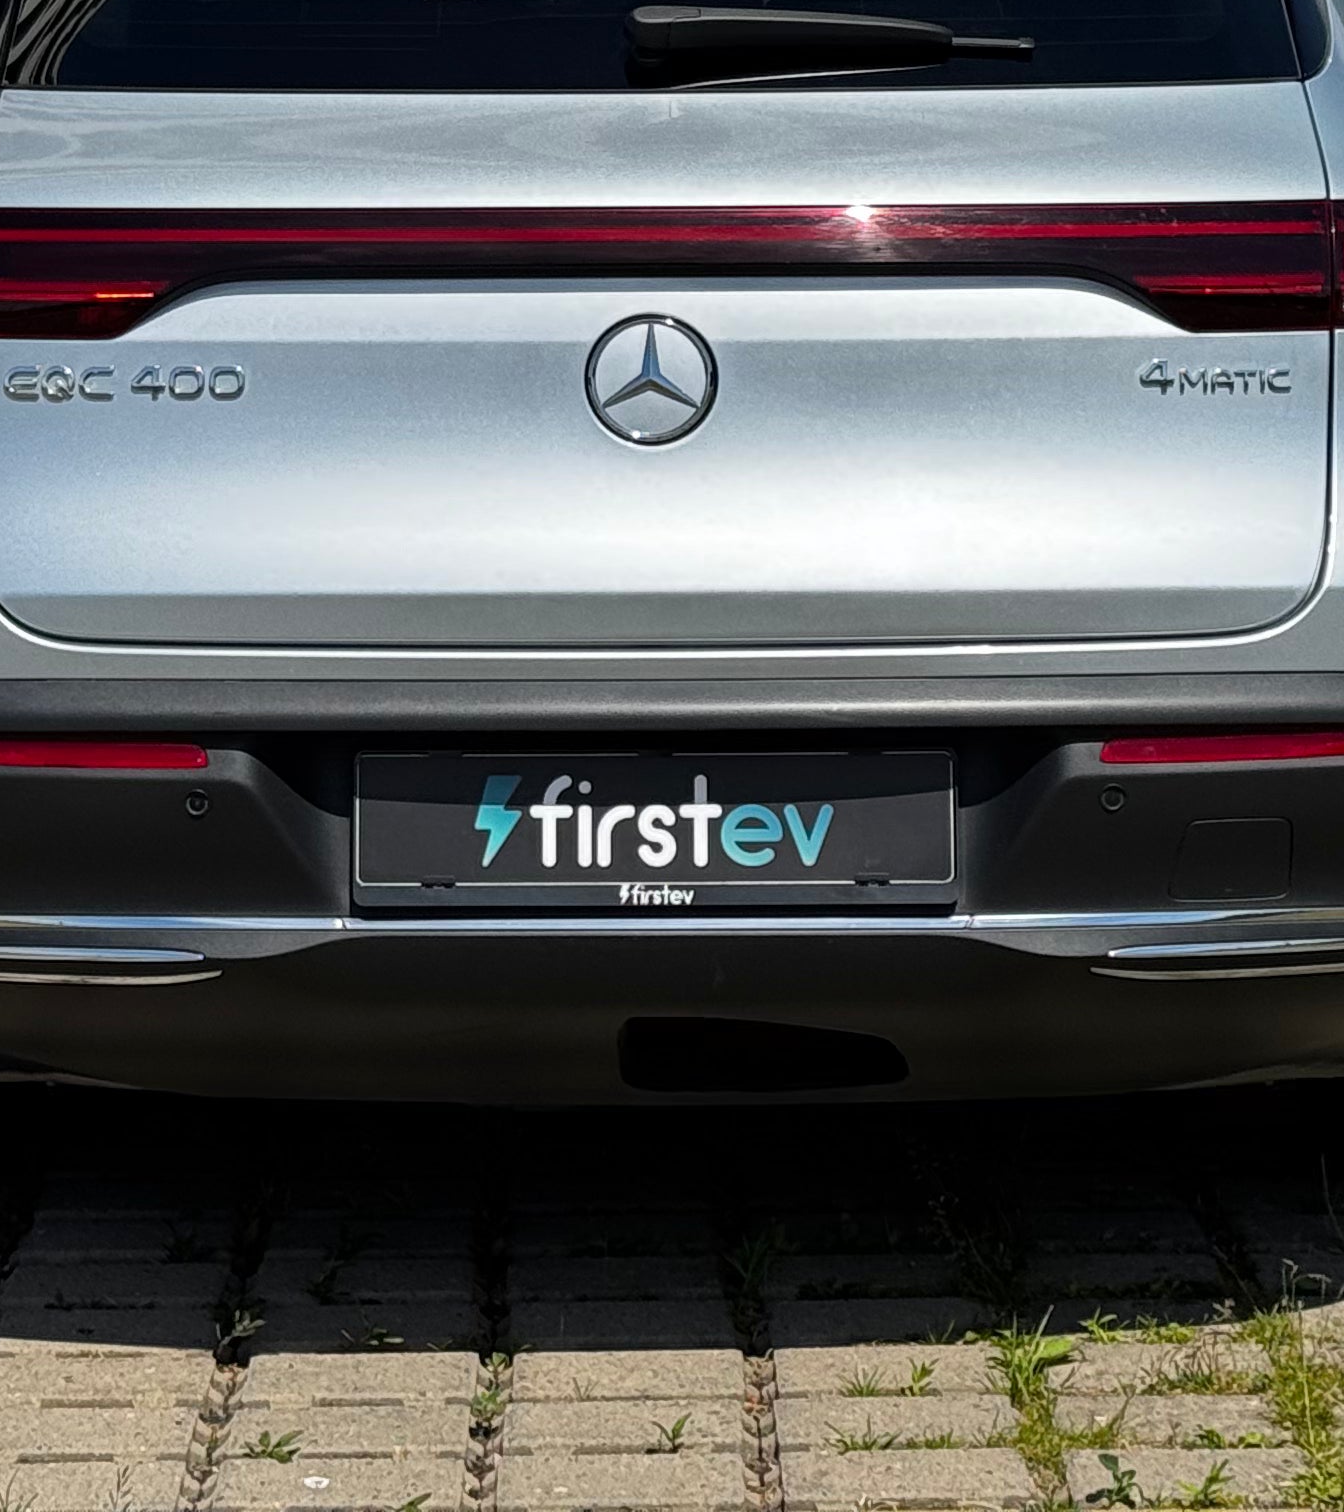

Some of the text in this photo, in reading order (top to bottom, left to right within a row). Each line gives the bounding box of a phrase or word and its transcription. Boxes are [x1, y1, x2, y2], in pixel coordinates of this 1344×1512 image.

[3, 364, 246, 402] EQC 400
[1138, 357, 1293, 396] 4MATIC
[529, 773, 835, 868] firstev
[632, 884, 695, 907] firstev
